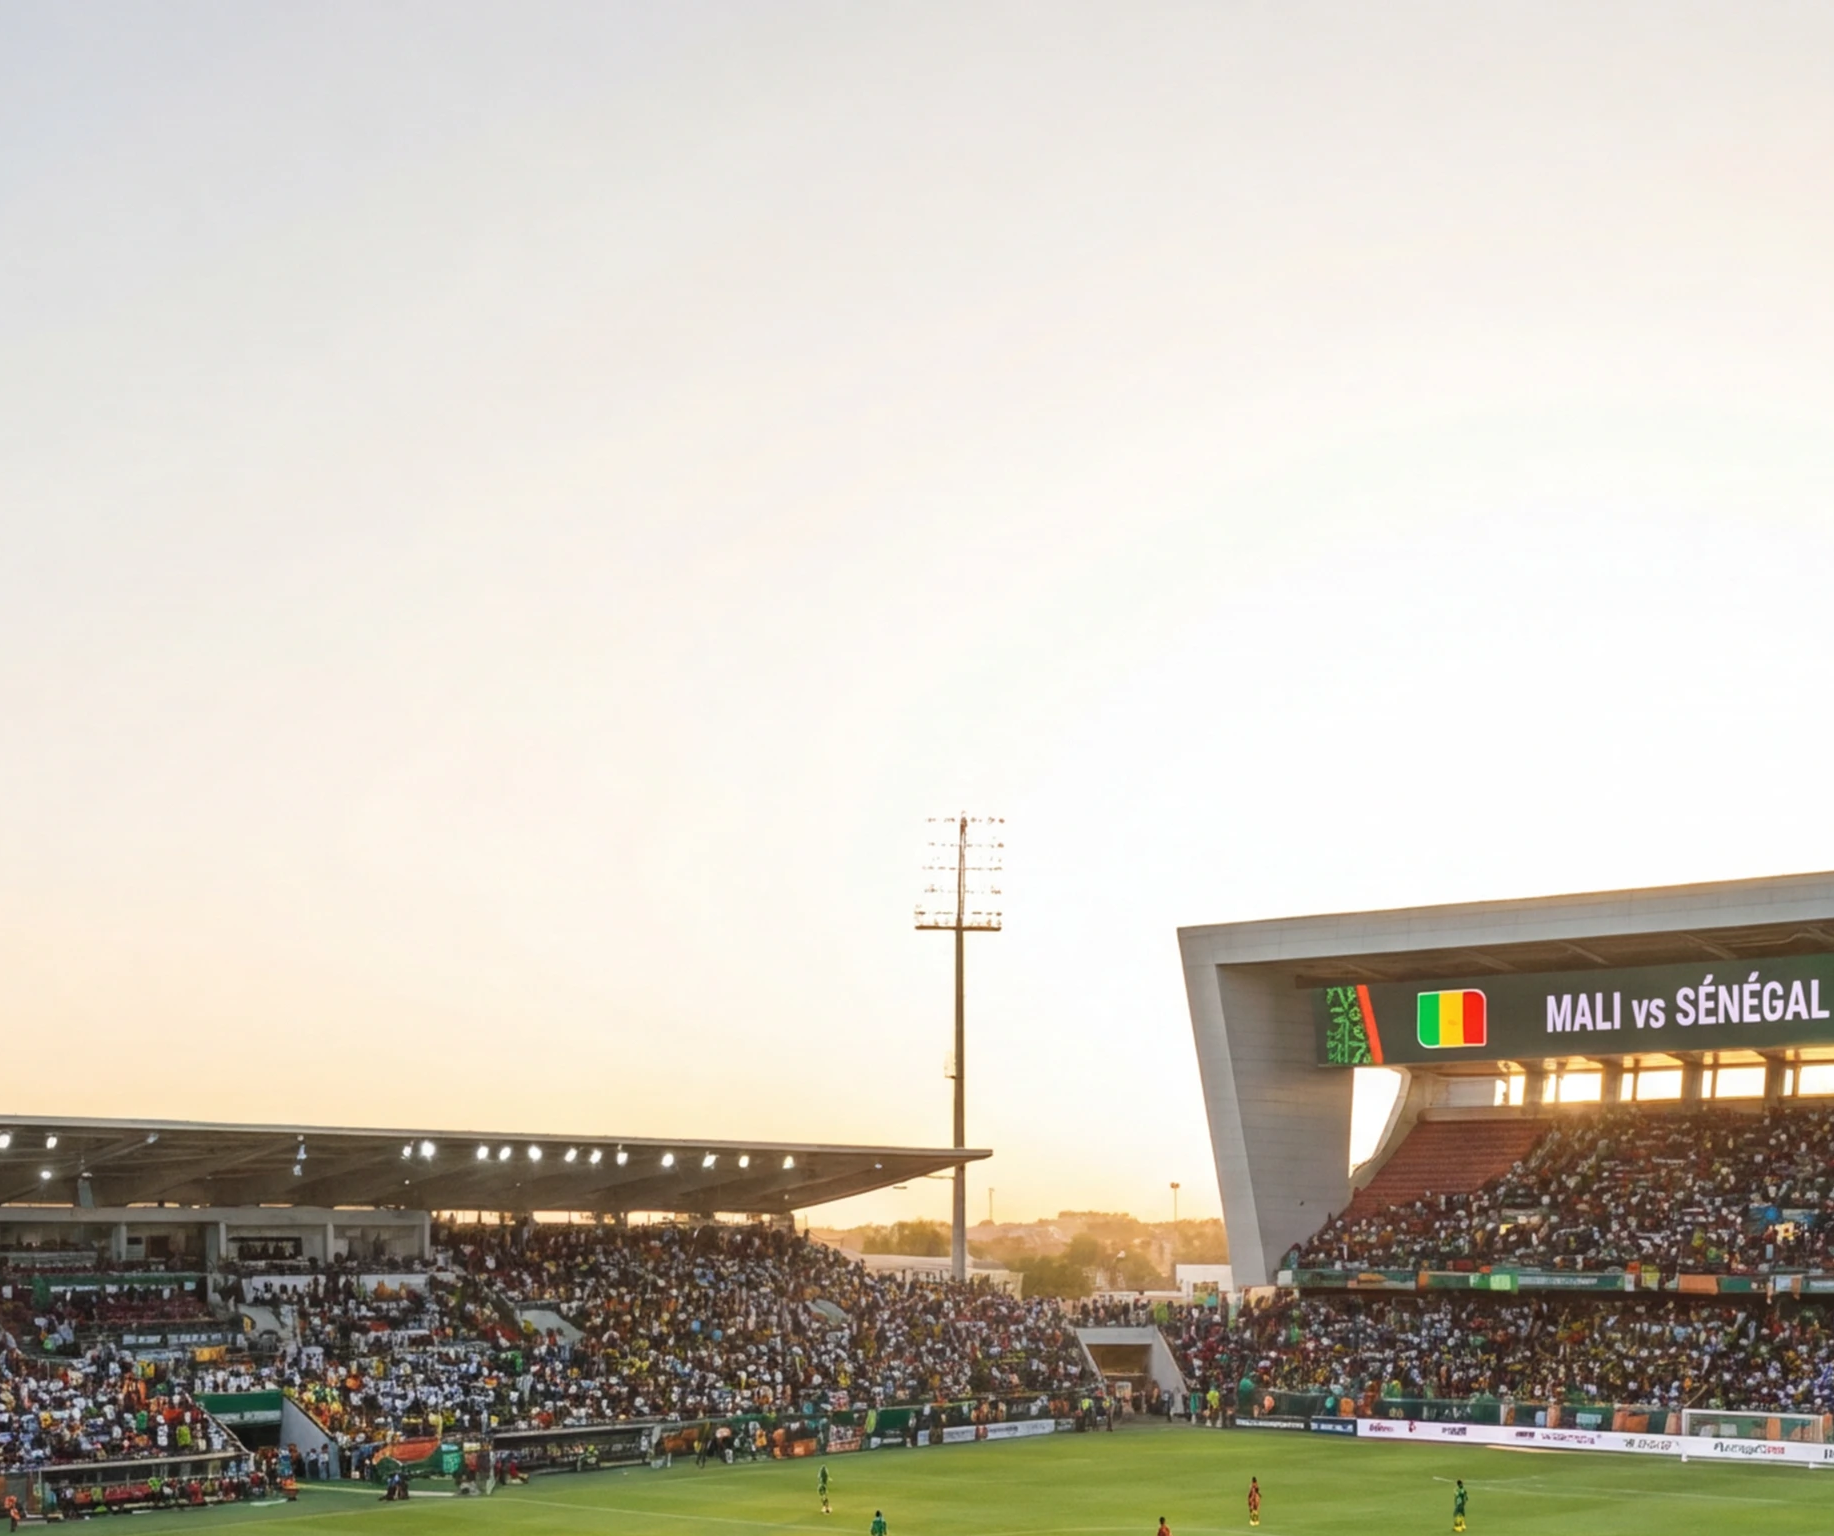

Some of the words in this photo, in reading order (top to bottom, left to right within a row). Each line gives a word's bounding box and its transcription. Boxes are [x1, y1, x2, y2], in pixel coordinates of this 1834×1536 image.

[1546, 991, 1622, 1033] MALI
[1631, 998, 1666, 1029] vs
[1675, 971, 1830, 1026] SÉNÉGAL
